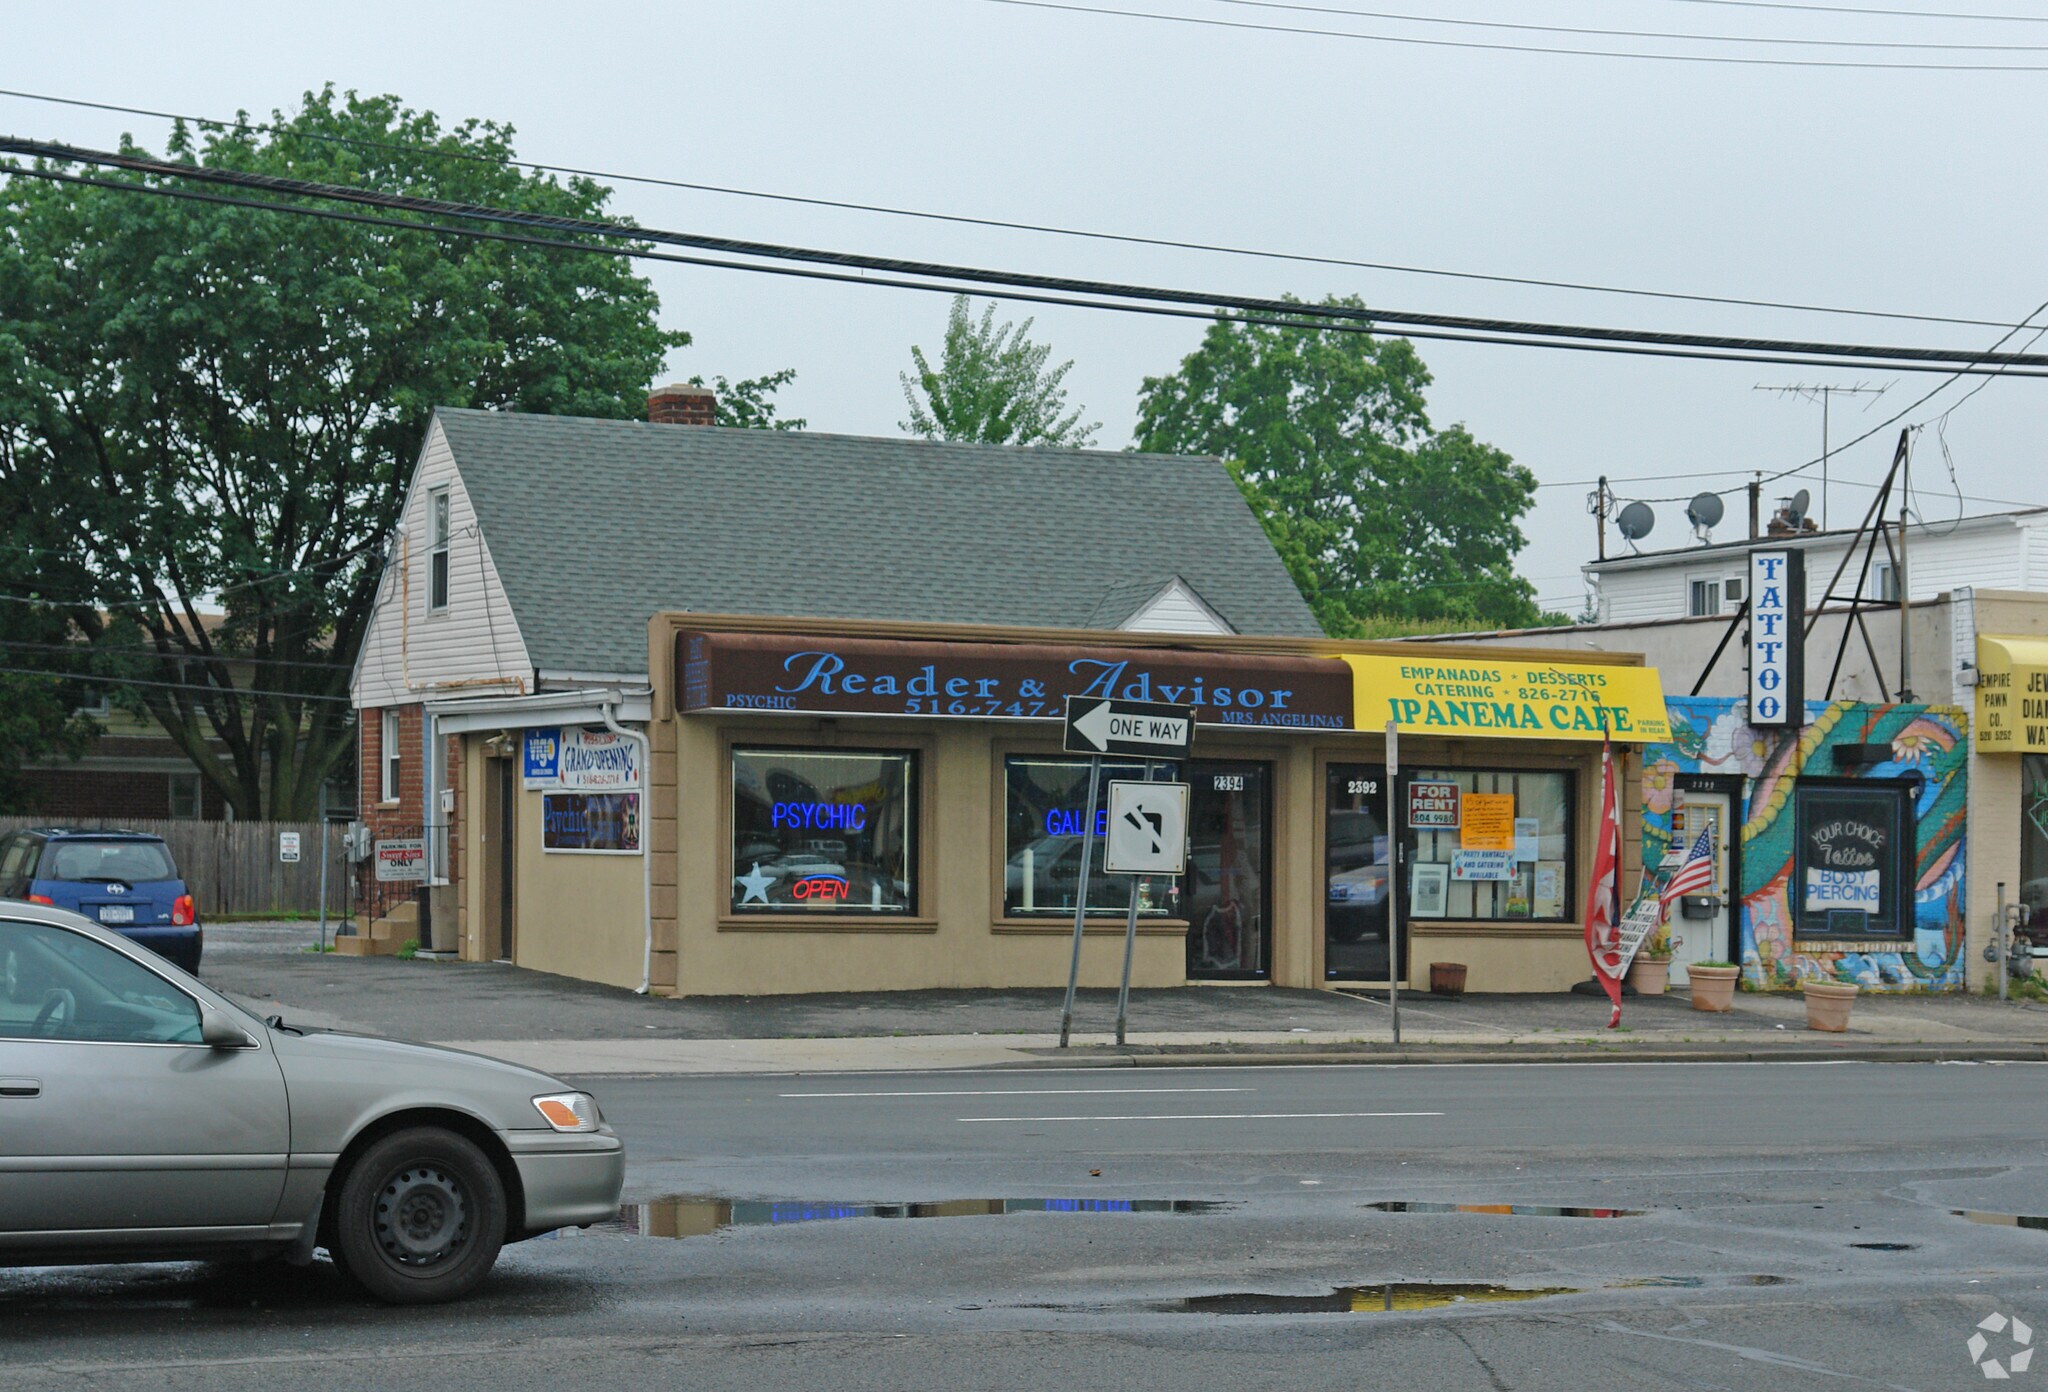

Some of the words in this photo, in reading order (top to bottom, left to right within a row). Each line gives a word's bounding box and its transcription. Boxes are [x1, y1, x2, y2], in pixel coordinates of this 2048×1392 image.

[1757, 558, 1784, 719] TATTOO
[775, 651, 1000, 698] Reader
[1018, 679, 1046, 698] &
[1063, 658, 1294, 708] Advisor
[1400, 666, 1502, 683] EMPANADAS
[1527, 671, 1607, 687] DESSERTS
[1981, 672, 2011, 688] EMPIRE
[726, 693, 797, 710] PSYCHIC
[1414, 682, 1495, 698] CATERING
[1518, 687, 1600, 702] 826-2716
[1984, 692, 2008, 708] PAWN
[904, 698, 1068, 717] 516-747-
[1387, 698, 1544, 729] IPANEMA
[1549, 704, 1633, 732] CAFE
[1109, 718, 1144, 737] ONE
[1149, 721, 1183, 740] WAY
[1222, 711, 1257, 725] MRS.
[1260, 712, 1344, 728] ANGELINAS
[1989, 712, 2003, 728] CO.
[1995, 730, 2012, 741] 5252
[2026, 725, 2048, 746] WA
[565, 746, 595, 773] GRAND
[596, 743, 634, 772] OPENING
[1215, 776, 1242, 790] 2394
[1347, 781, 1377, 794] 2392
[1417, 786, 1451, 798] FOR
[1412, 798, 1456, 810] RENT
[544, 796, 587, 846] Psychic
[772, 801, 866, 831] PSYCHIC
[1046, 807, 1107, 836] GALE
[1414, 813, 1430, 823] 804
[1433, 813, 1455, 823] 9980
[1811, 822, 1843, 845] YOUR
[1845, 821, 1885, 849] CHOICE
[390, 859, 414, 867] ONLY
[1819, 844, 1875, 866] Tattoo
[1821, 868, 1866, 884] BODY
[792, 879, 850, 900] OPEN
[1804, 884, 1879, 901] PIERCING
